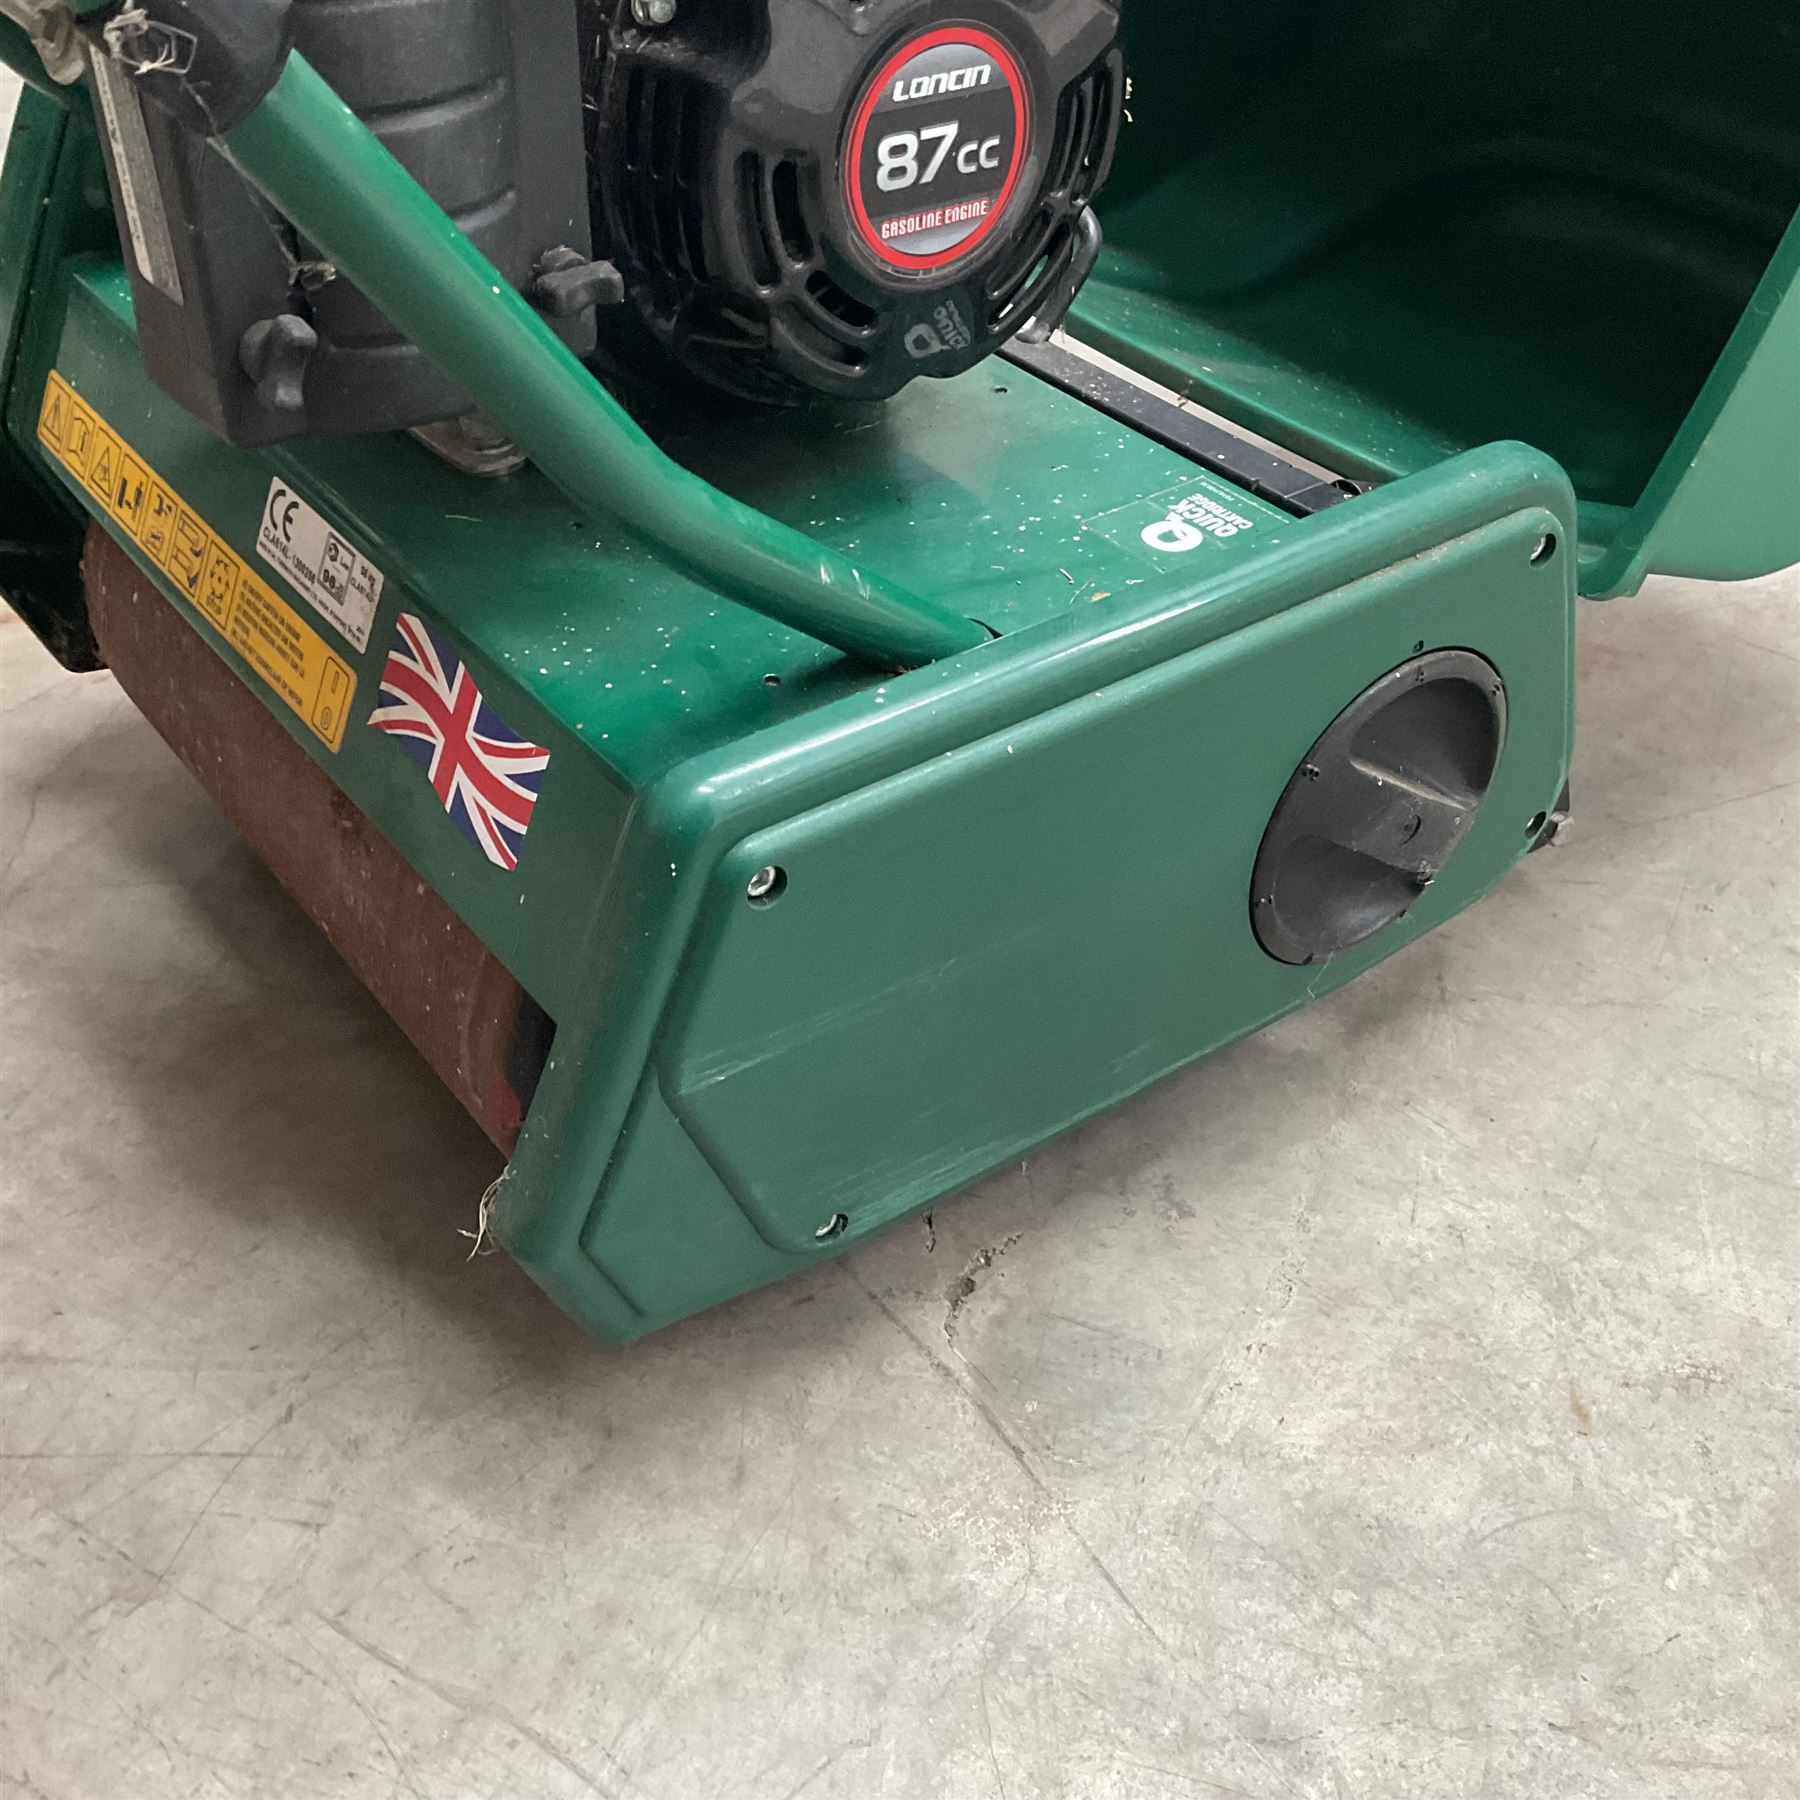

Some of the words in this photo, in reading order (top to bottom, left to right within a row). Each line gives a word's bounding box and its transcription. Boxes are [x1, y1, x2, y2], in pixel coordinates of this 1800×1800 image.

[892, 64, 992, 102] LONCIN
[881, 208, 943, 240] GASOLINE
[944, 199, 989, 225] ENGINE
[269, 489, 299, 543] CE
[1168, 498, 1239, 538] QUICK
[1188, 493, 1254, 530] CARTRIDGE
